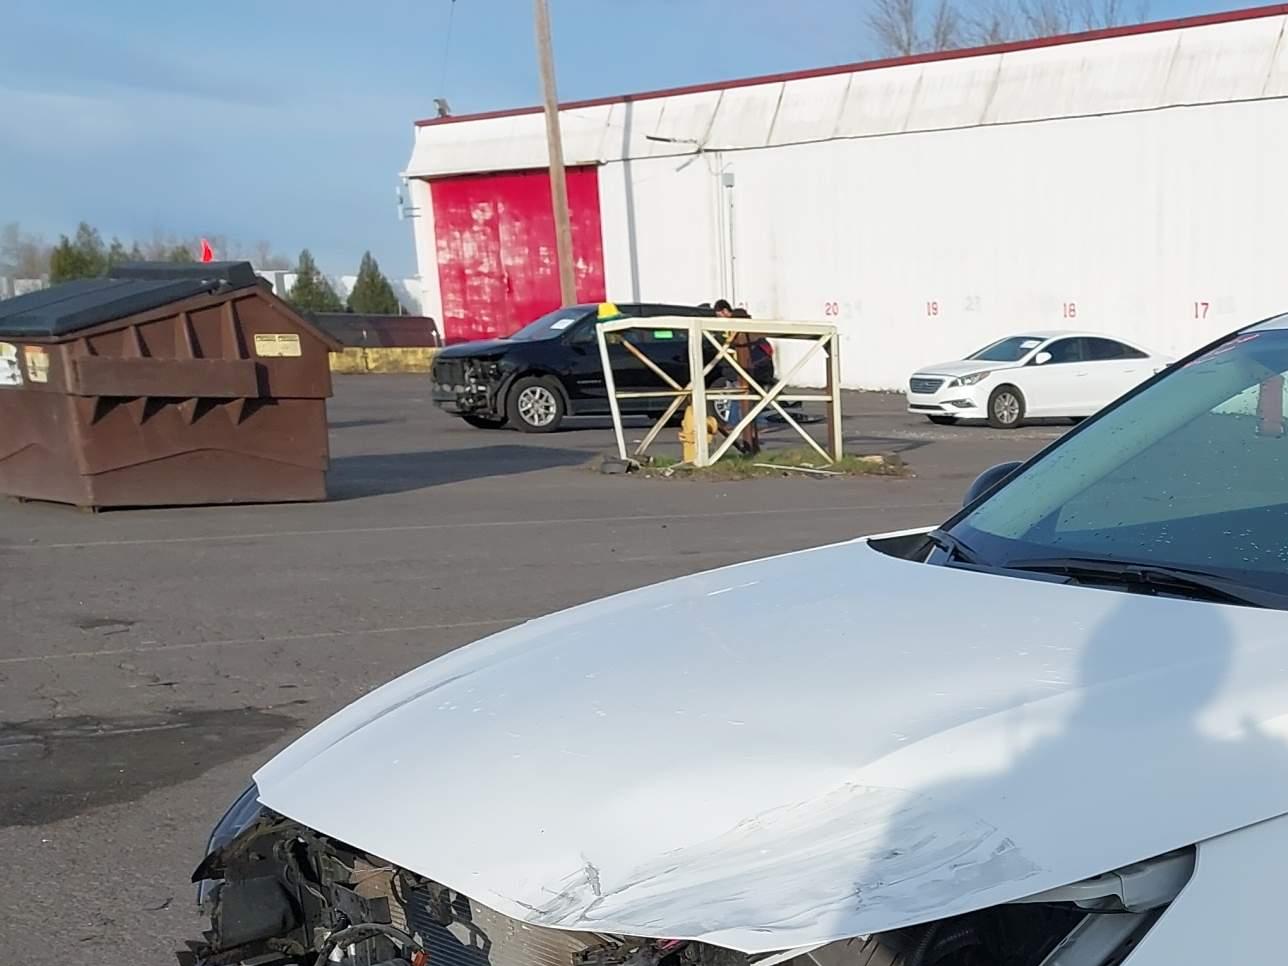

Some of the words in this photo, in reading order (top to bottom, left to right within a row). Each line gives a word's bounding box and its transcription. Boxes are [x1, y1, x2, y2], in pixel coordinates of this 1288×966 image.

[825, 302, 839, 316] 20
[926, 301, 939, 316] 19
[1063, 302, 1077, 318] 18
[1194, 302, 1210, 319] 17
